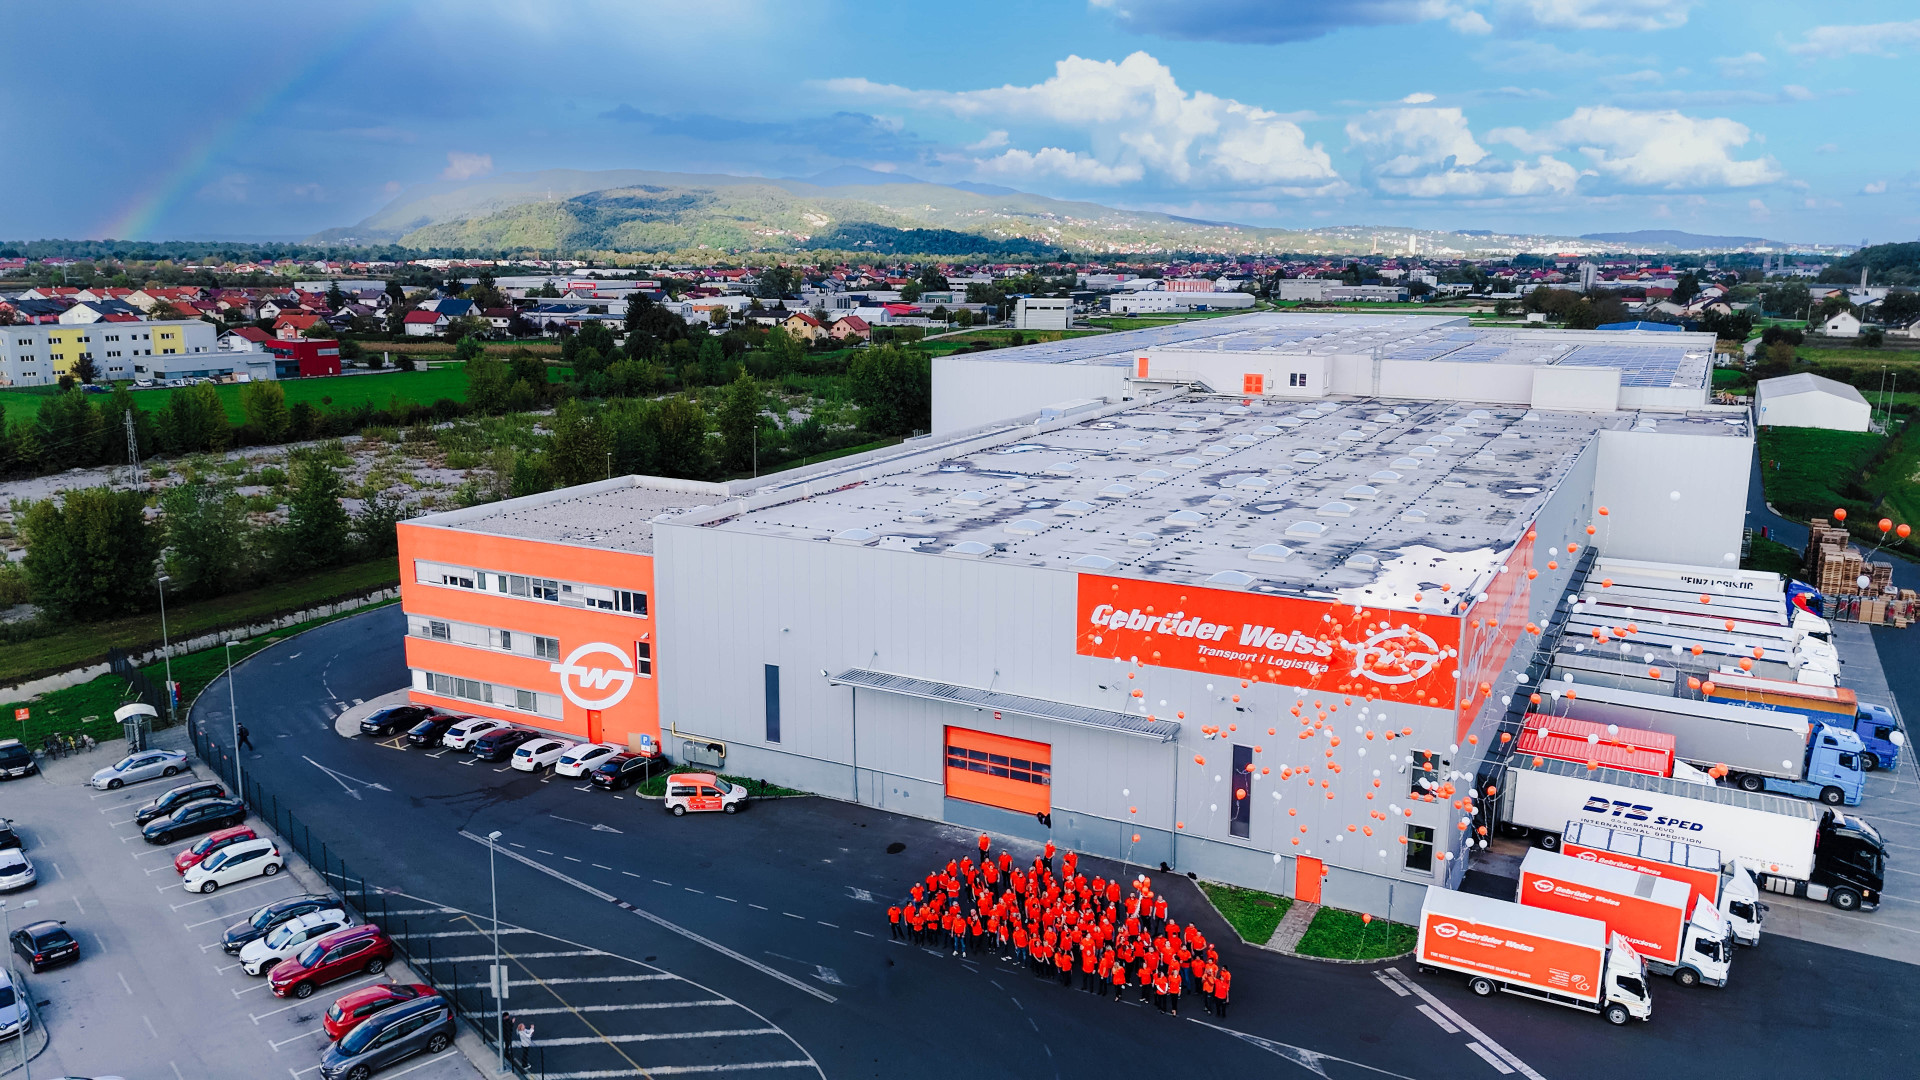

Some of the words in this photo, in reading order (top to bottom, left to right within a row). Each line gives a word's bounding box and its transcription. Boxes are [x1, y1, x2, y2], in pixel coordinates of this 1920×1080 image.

[1090, 604, 1229, 642] Gebrüder
[1239, 623, 1333, 657] Weiss
[1197, 645, 1258, 662] Transport
[1259, 654, 1266, 663] i
[1267, 655, 1330, 673] Logistika
[1582, 796, 1654, 821] DTS
[1654, 816, 1704, 832] SPED
[1633, 822, 1675, 833] SARAJEVO
[1580, 818, 1650, 835] INTERNATIONAL
[1655, 832, 1702, 845] SPEDITION
[1458, 930, 1504, 945] Gebrüder
[1505, 940, 1535, 952] Weiss
